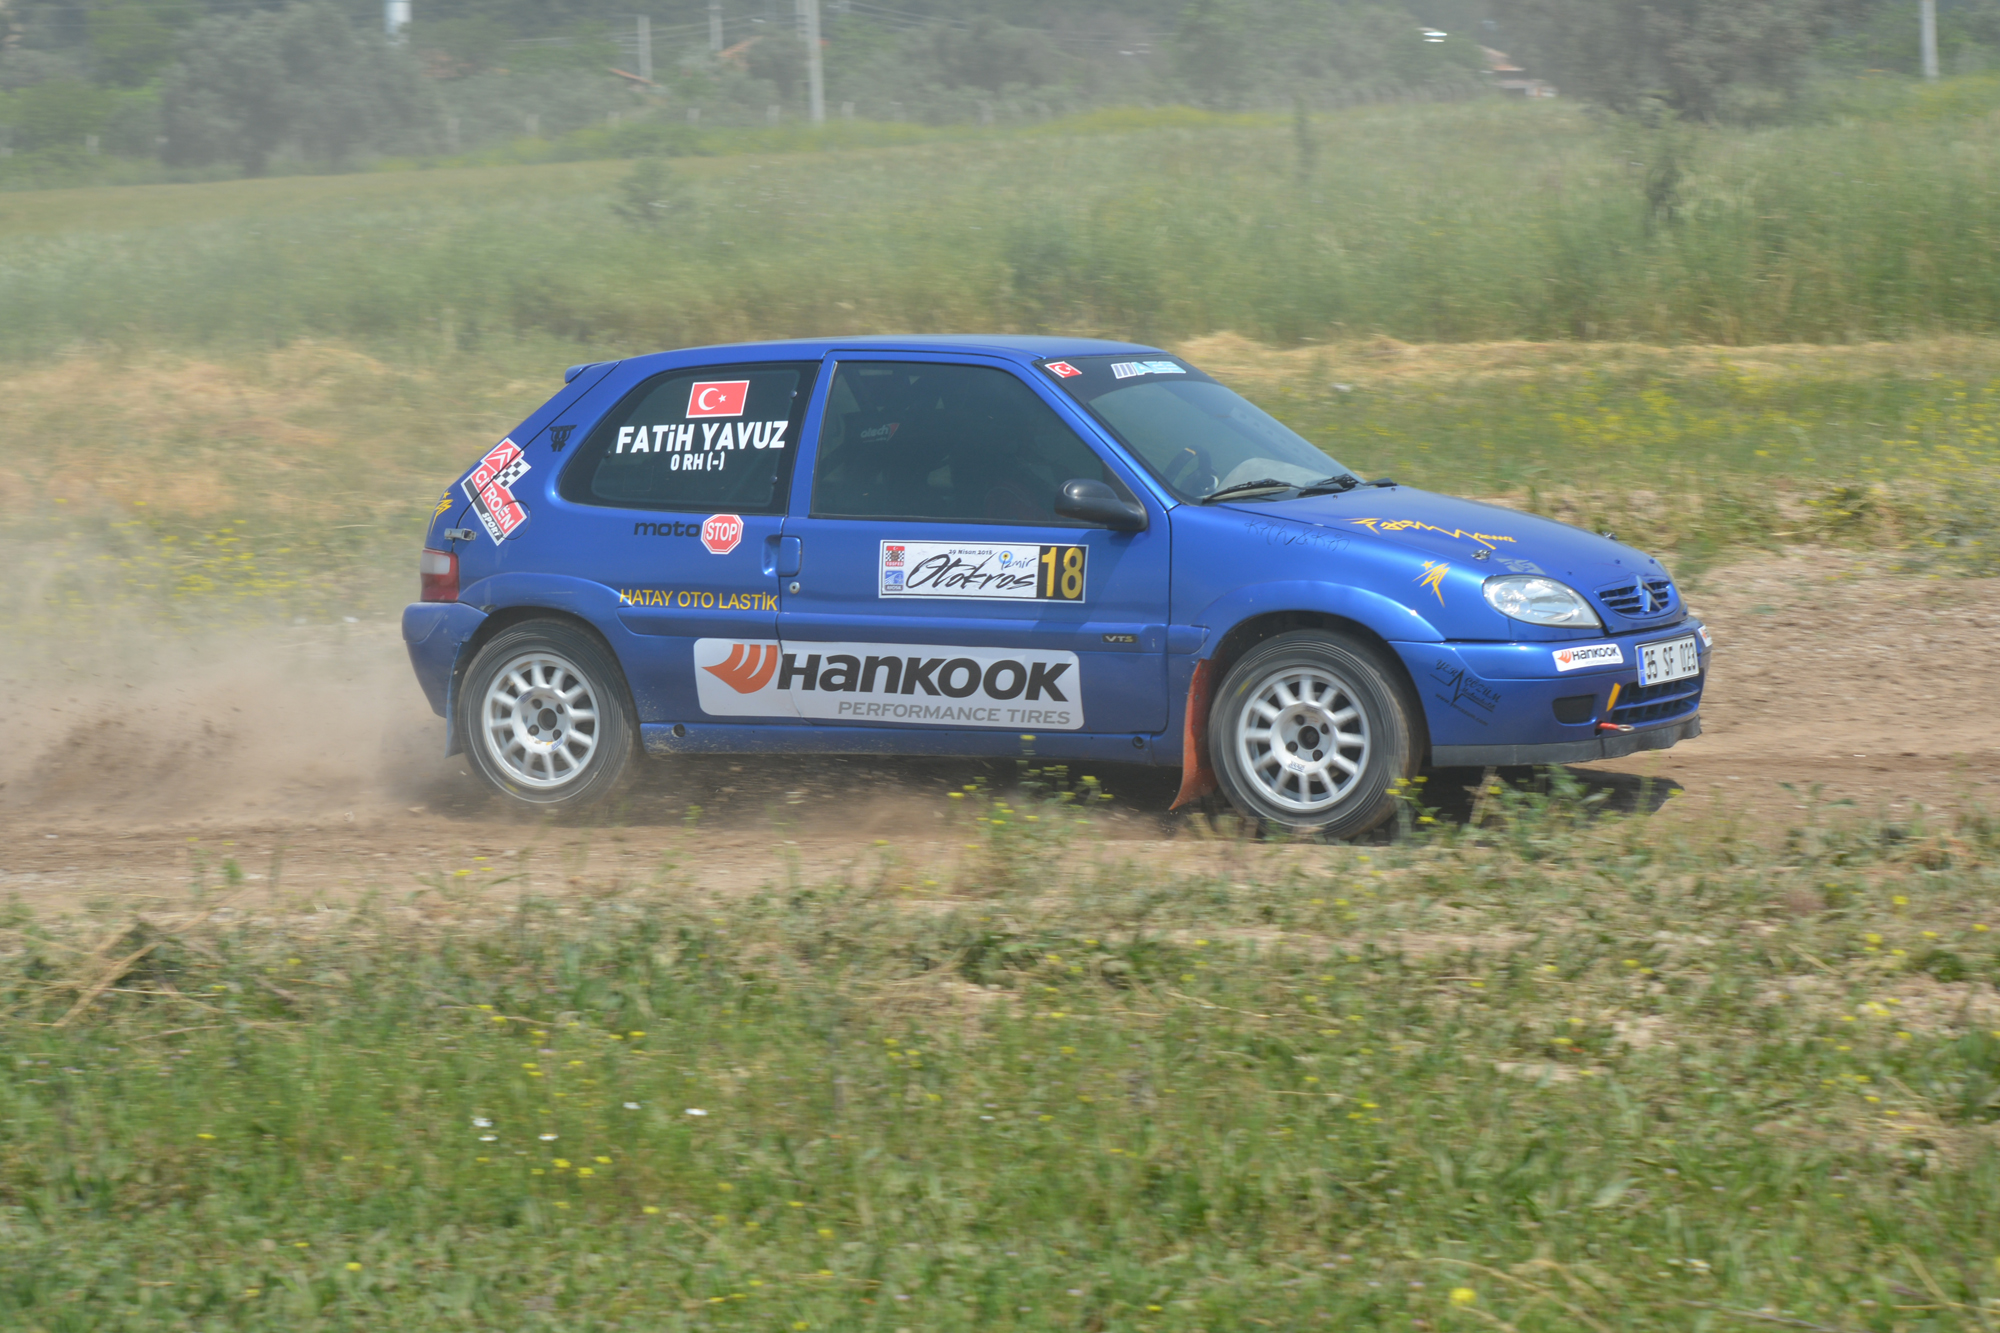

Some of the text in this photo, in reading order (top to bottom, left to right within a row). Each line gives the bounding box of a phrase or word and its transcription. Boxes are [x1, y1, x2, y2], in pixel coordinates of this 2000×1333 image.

[702, 420, 789, 451] YAVUZ
[682, 453, 704, 471] RH
[481, 511, 500, 537] SPORT
[633, 521, 738, 541] moto STOP
[1041, 546, 1083, 600] 18
[619, 588, 779, 611] HATAY OTO LASTİK
[1105, 635, 1134, 643] VTS
[1644, 649, 1658, 680] 35
[1662, 645, 1675, 676] SF
[838, 701, 1071, 725] PERFORMANCE TIRES
